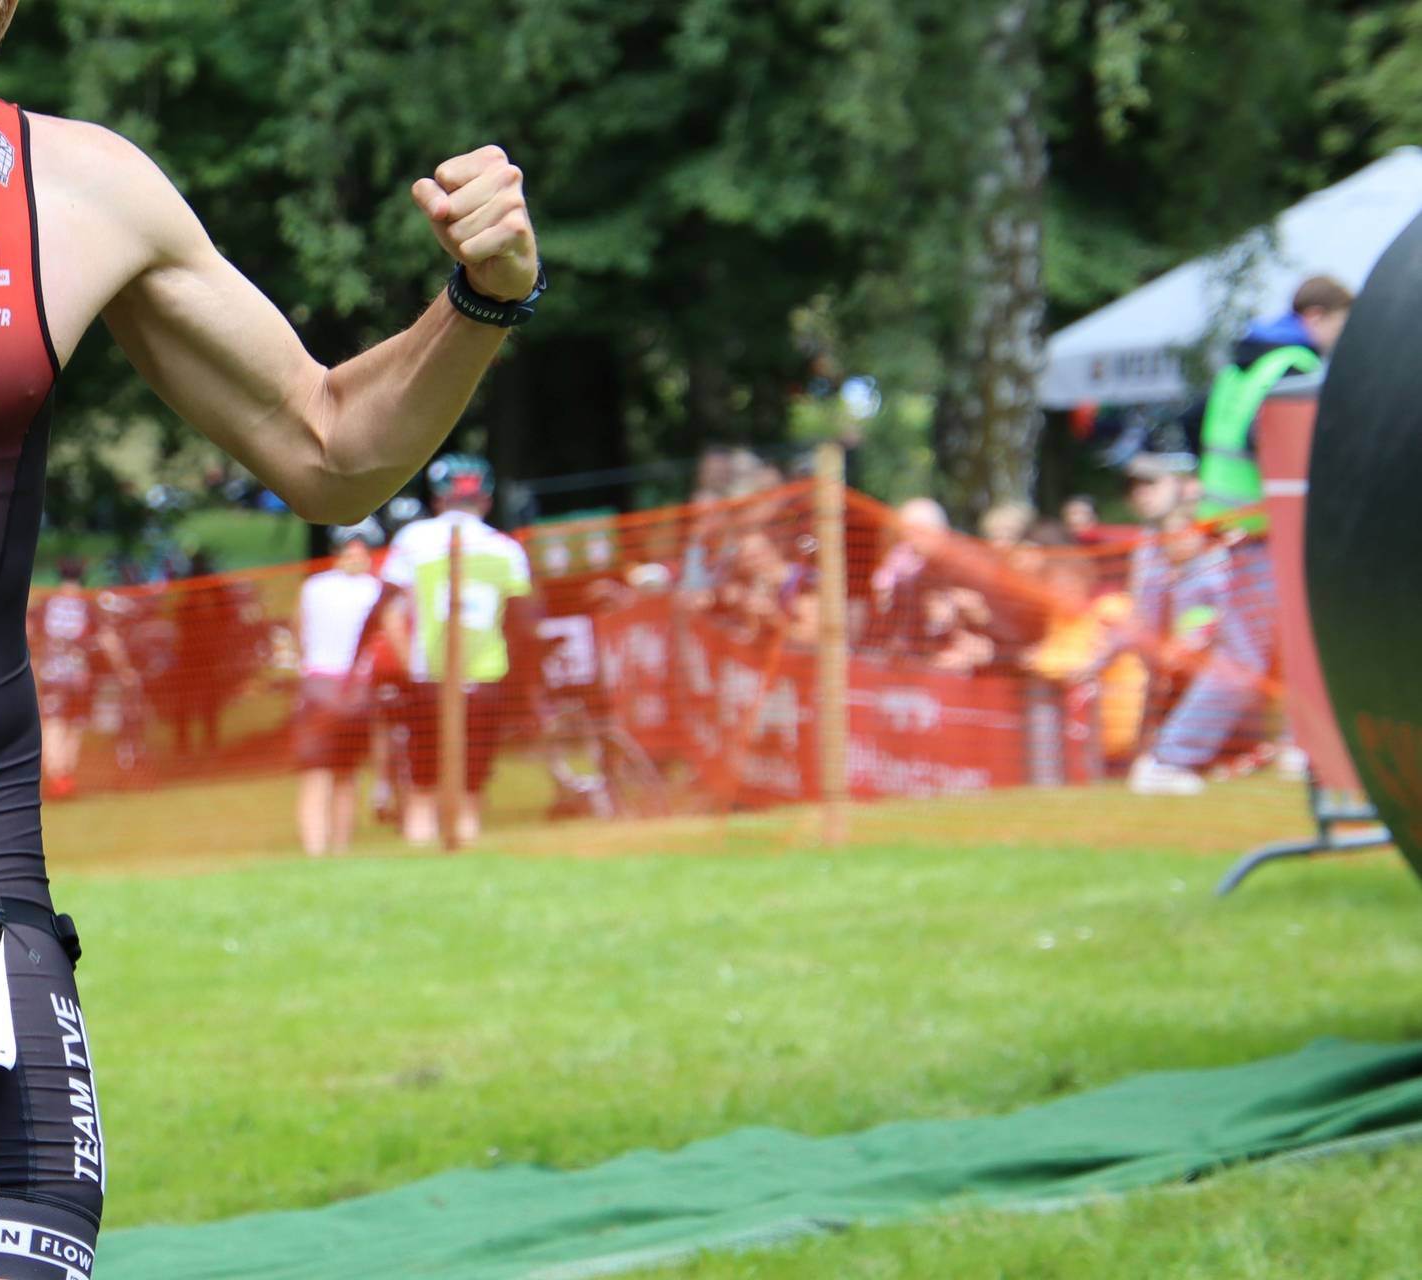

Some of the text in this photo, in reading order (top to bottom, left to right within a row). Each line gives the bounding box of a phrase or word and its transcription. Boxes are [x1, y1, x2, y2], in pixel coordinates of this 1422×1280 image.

[50, 992, 100, 1183] TEAM TVE
[0, 1229, 92, 1271] N FLOW
